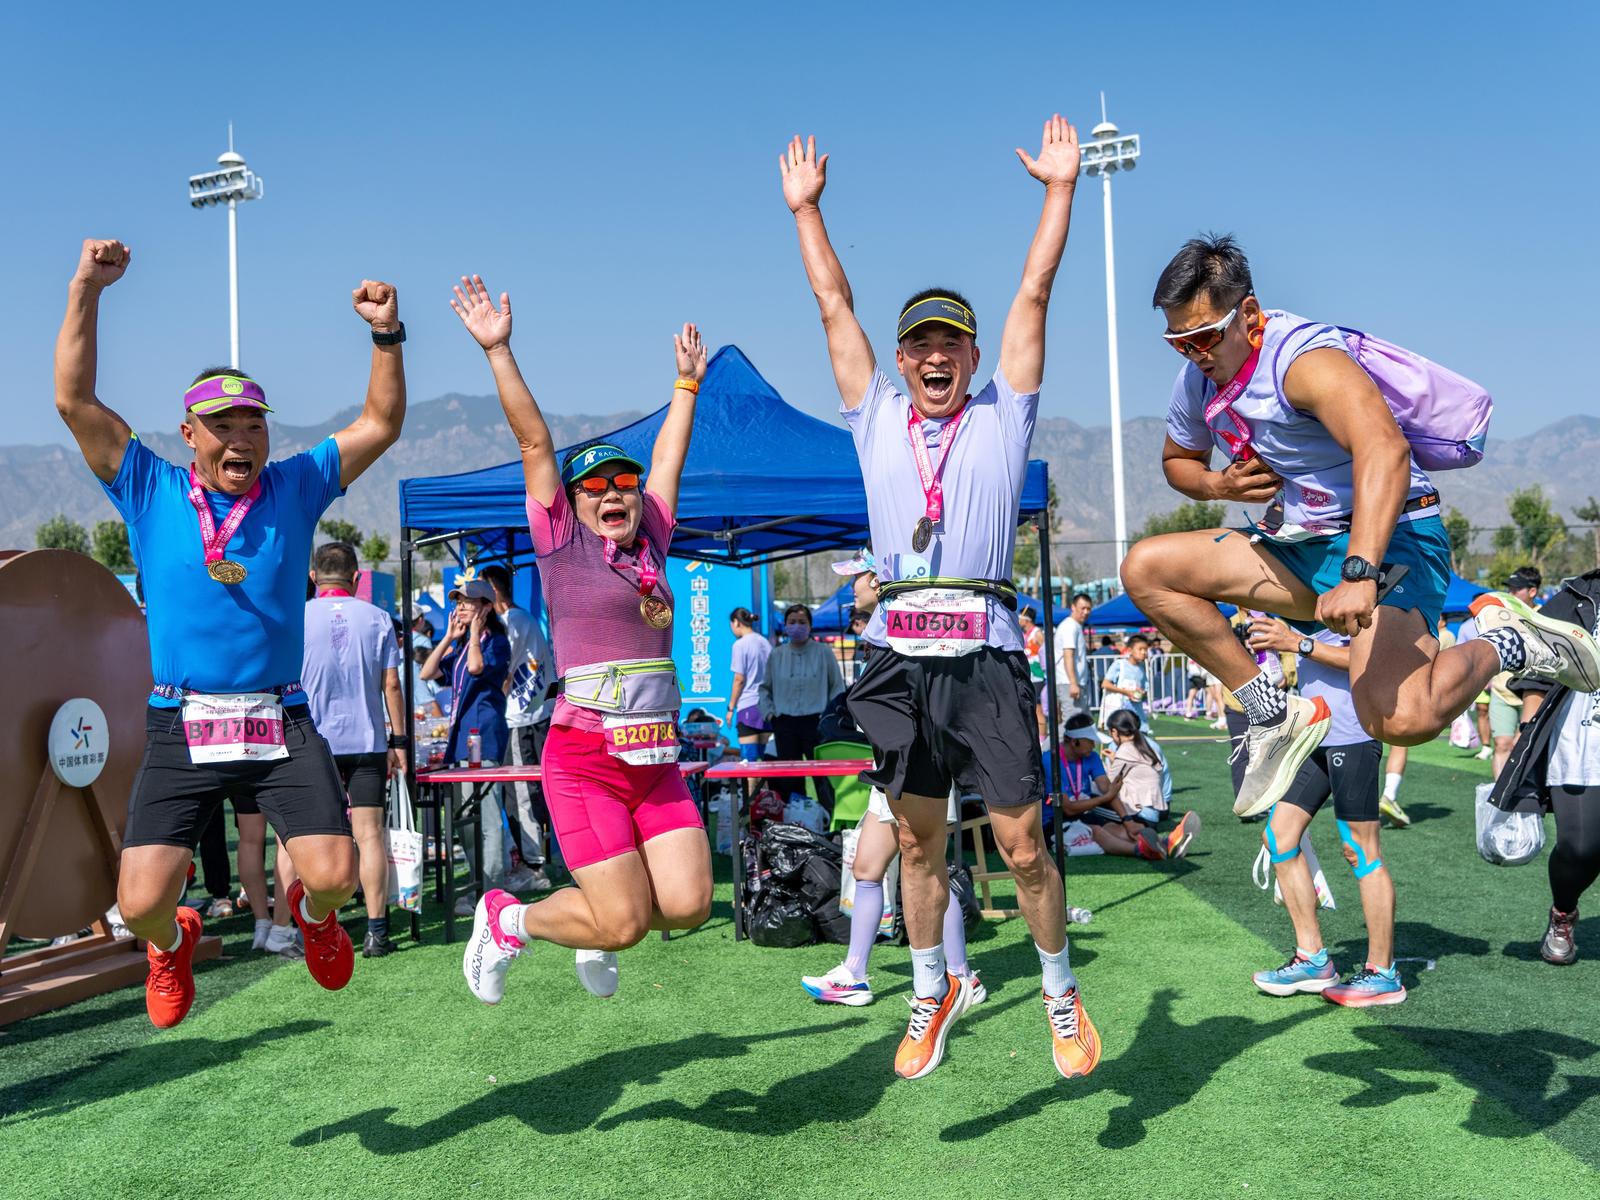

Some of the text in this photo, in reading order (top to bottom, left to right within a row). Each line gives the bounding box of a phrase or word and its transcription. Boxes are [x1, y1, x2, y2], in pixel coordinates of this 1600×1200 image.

[892, 613, 969, 632] A10606
[690, 575, 712, 693] 中国体育彩票
[188, 720, 269, 740] B11700
[613, 723, 675, 746] B20786
[58, 752, 105, 769] 中国体育彩票
